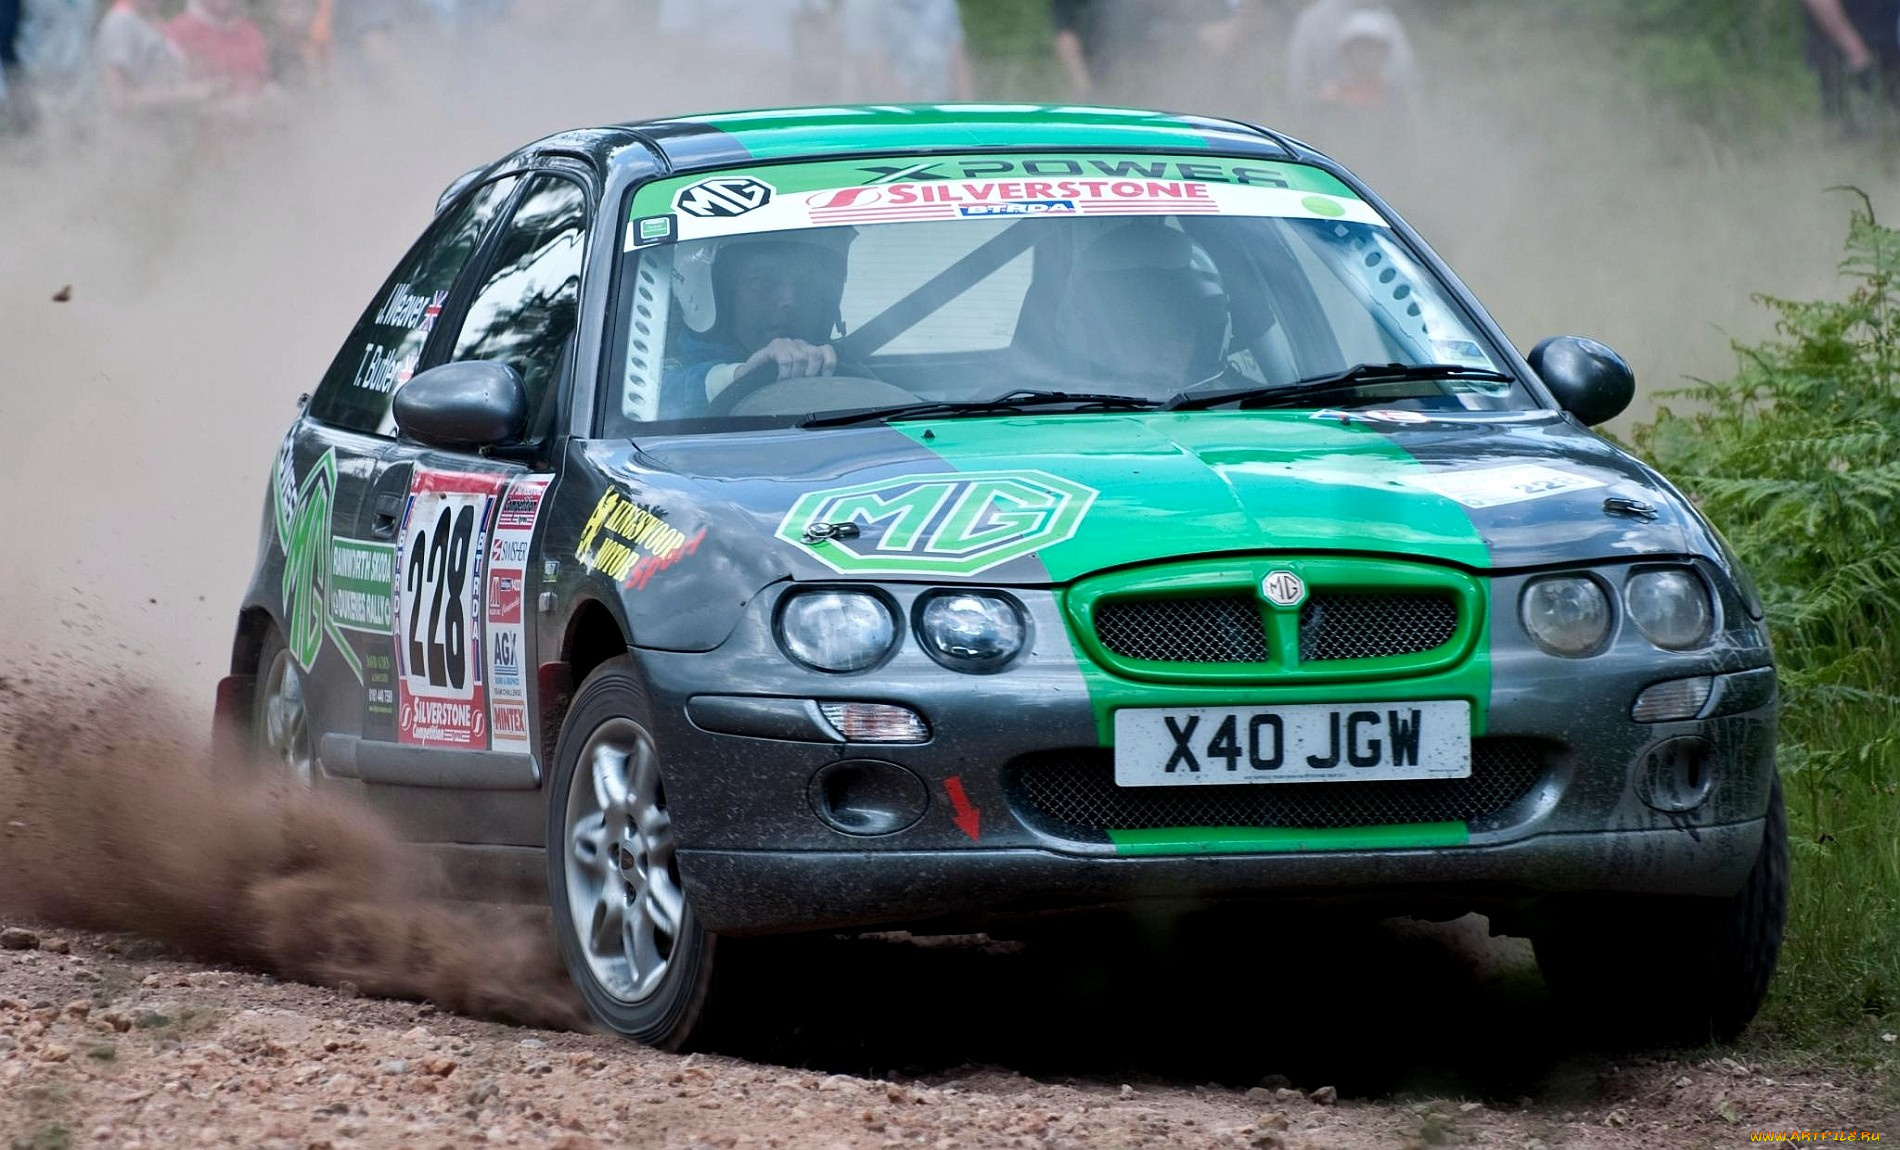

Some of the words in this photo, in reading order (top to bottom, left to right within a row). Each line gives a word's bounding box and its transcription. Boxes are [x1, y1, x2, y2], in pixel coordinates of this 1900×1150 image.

[855, 158, 1290, 188] XPOWER
[678, 178, 771, 216] MG
[887, 180, 1210, 205] SILVERSTONE
[966, 202, 1071, 215] BTRDA
[820, 480, 1057, 553] MG
[408, 504, 475, 690] 228
[471, 531, 486, 641] BTRDA
[1269, 575, 1299, 600] MG
[413, 696, 471, 728] SILVERSTONE
[494, 706, 525, 732] MINTEX
[412, 723, 445, 746] Competition
[1165, 713, 1284, 773] X40
[1306, 709, 1422, 769] JGW
